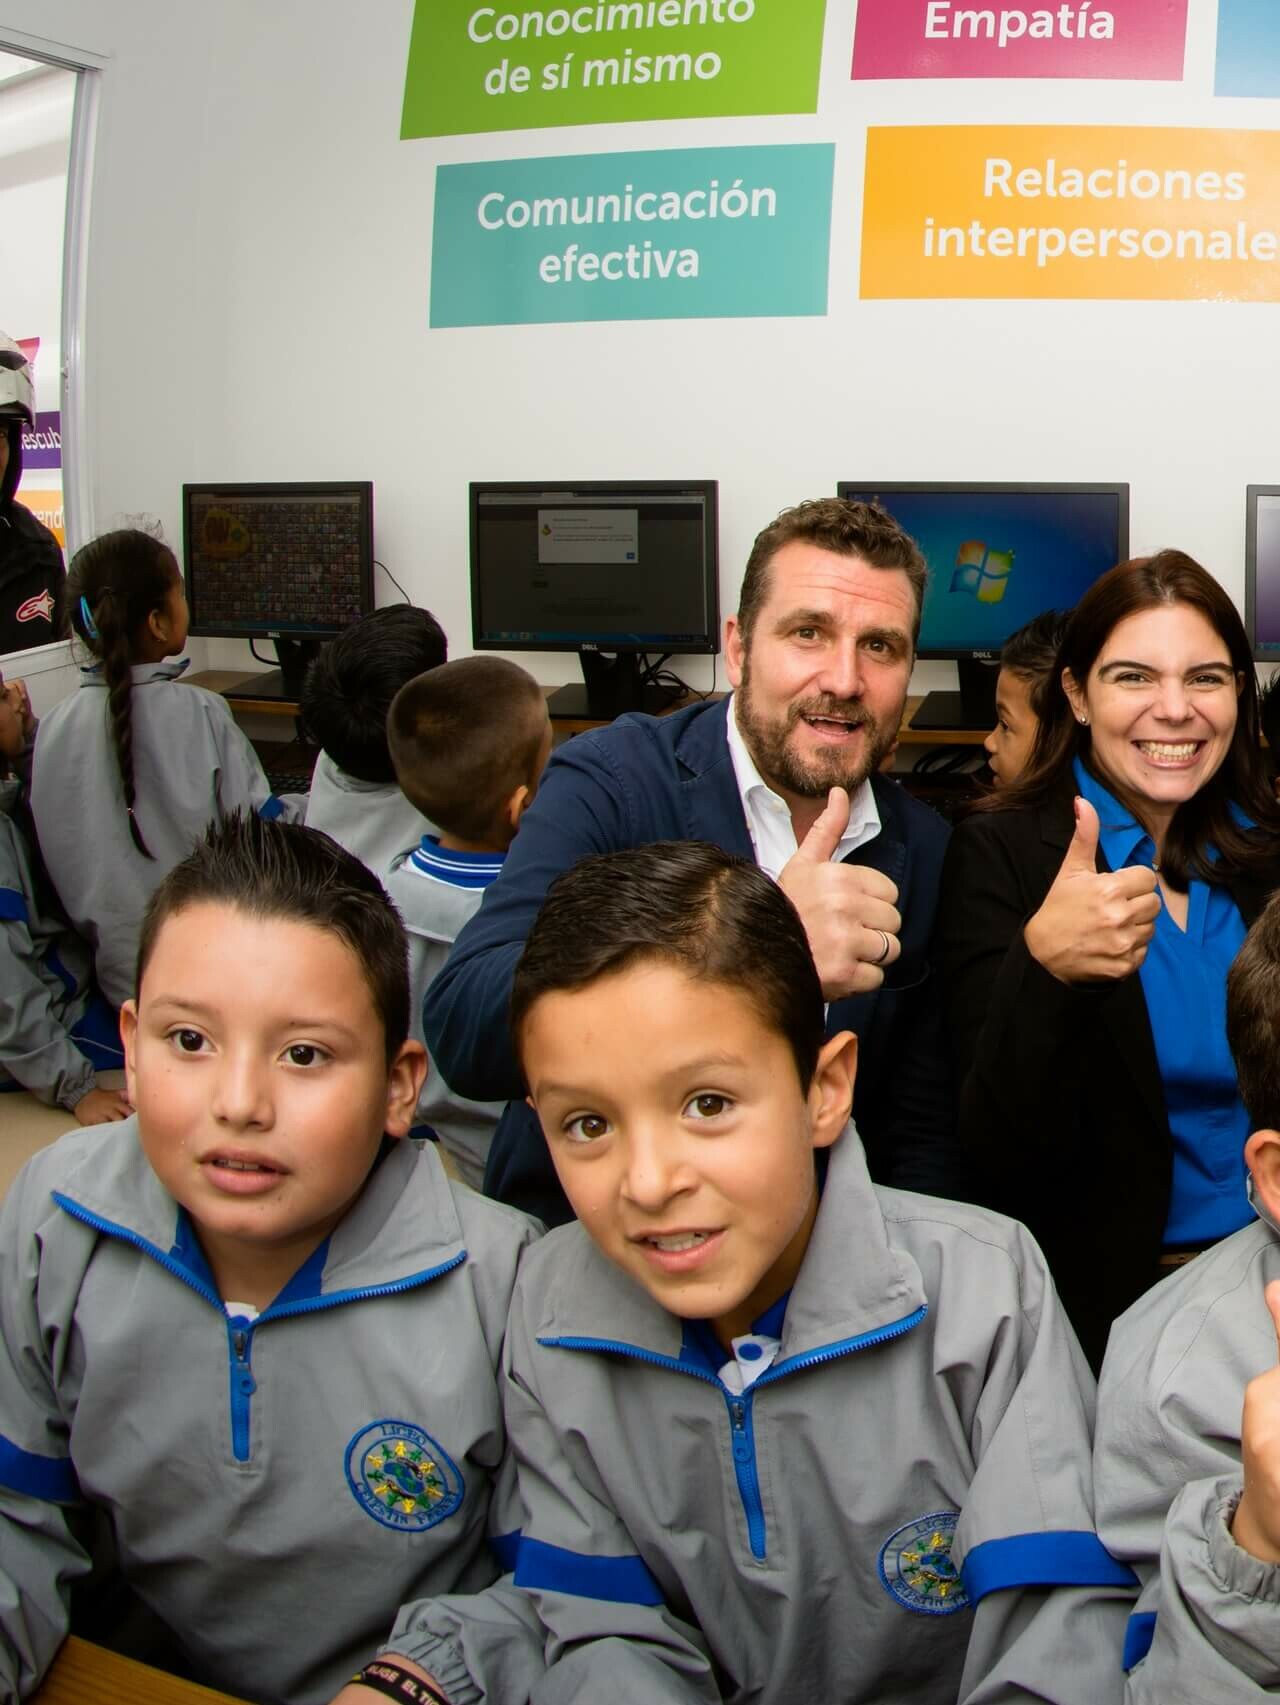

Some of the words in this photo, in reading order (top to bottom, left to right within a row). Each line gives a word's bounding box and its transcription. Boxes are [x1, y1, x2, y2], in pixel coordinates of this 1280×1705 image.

[467, 0, 755, 43] Conocimiento
[924, 1, 1115, 48] Empatía
[484, 58, 531, 96] de
[541, 52, 574, 91] sí
[582, 48, 722, 88] mismo
[984, 158, 1246, 203] Relaciones
[477, 178, 777, 230] Comunicación
[539, 240, 699, 284] efectiva
